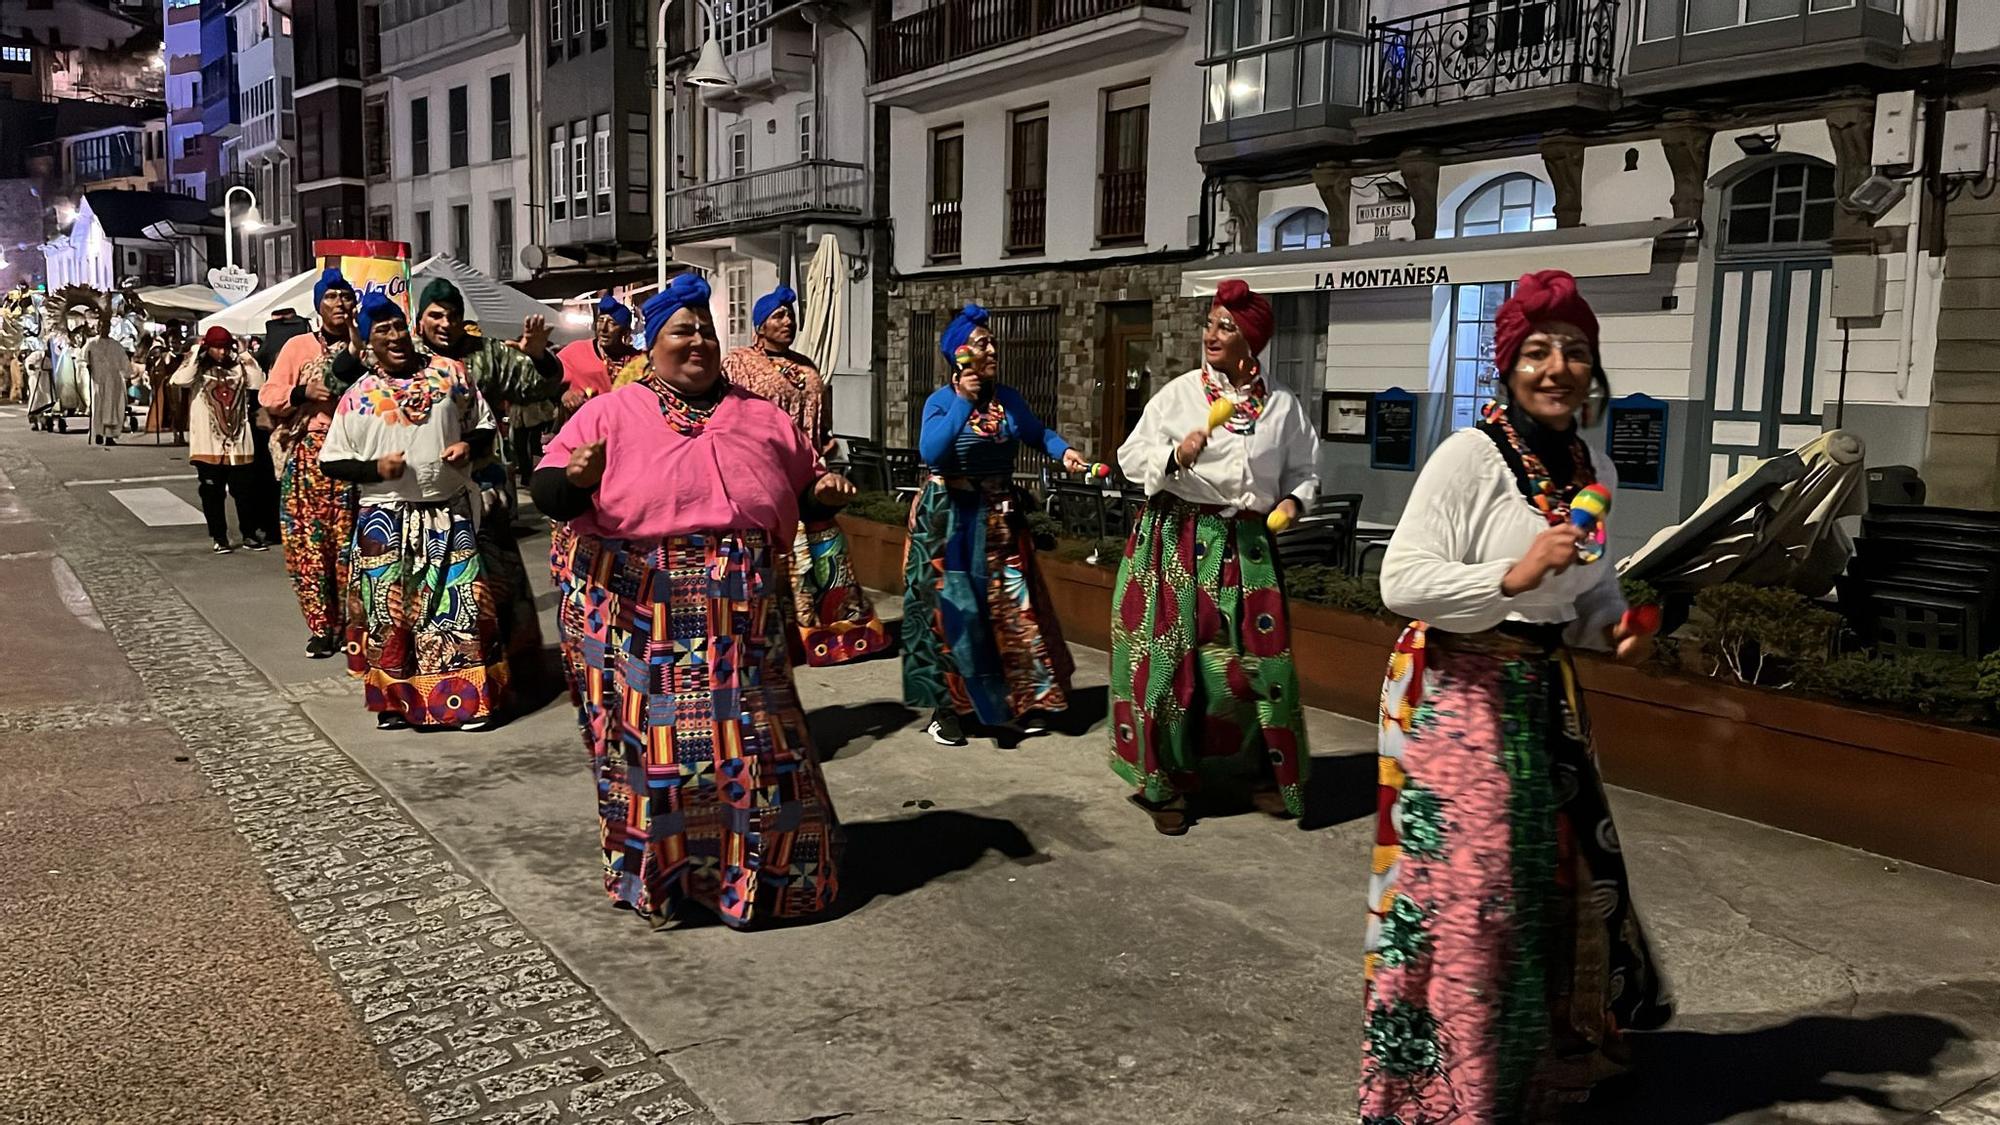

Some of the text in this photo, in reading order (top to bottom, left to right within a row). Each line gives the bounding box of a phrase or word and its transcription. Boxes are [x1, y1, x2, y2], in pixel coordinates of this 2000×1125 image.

[1375, 225, 1388, 237] DEL
[1315, 263, 1450, 290] LA MONTAÑESA
